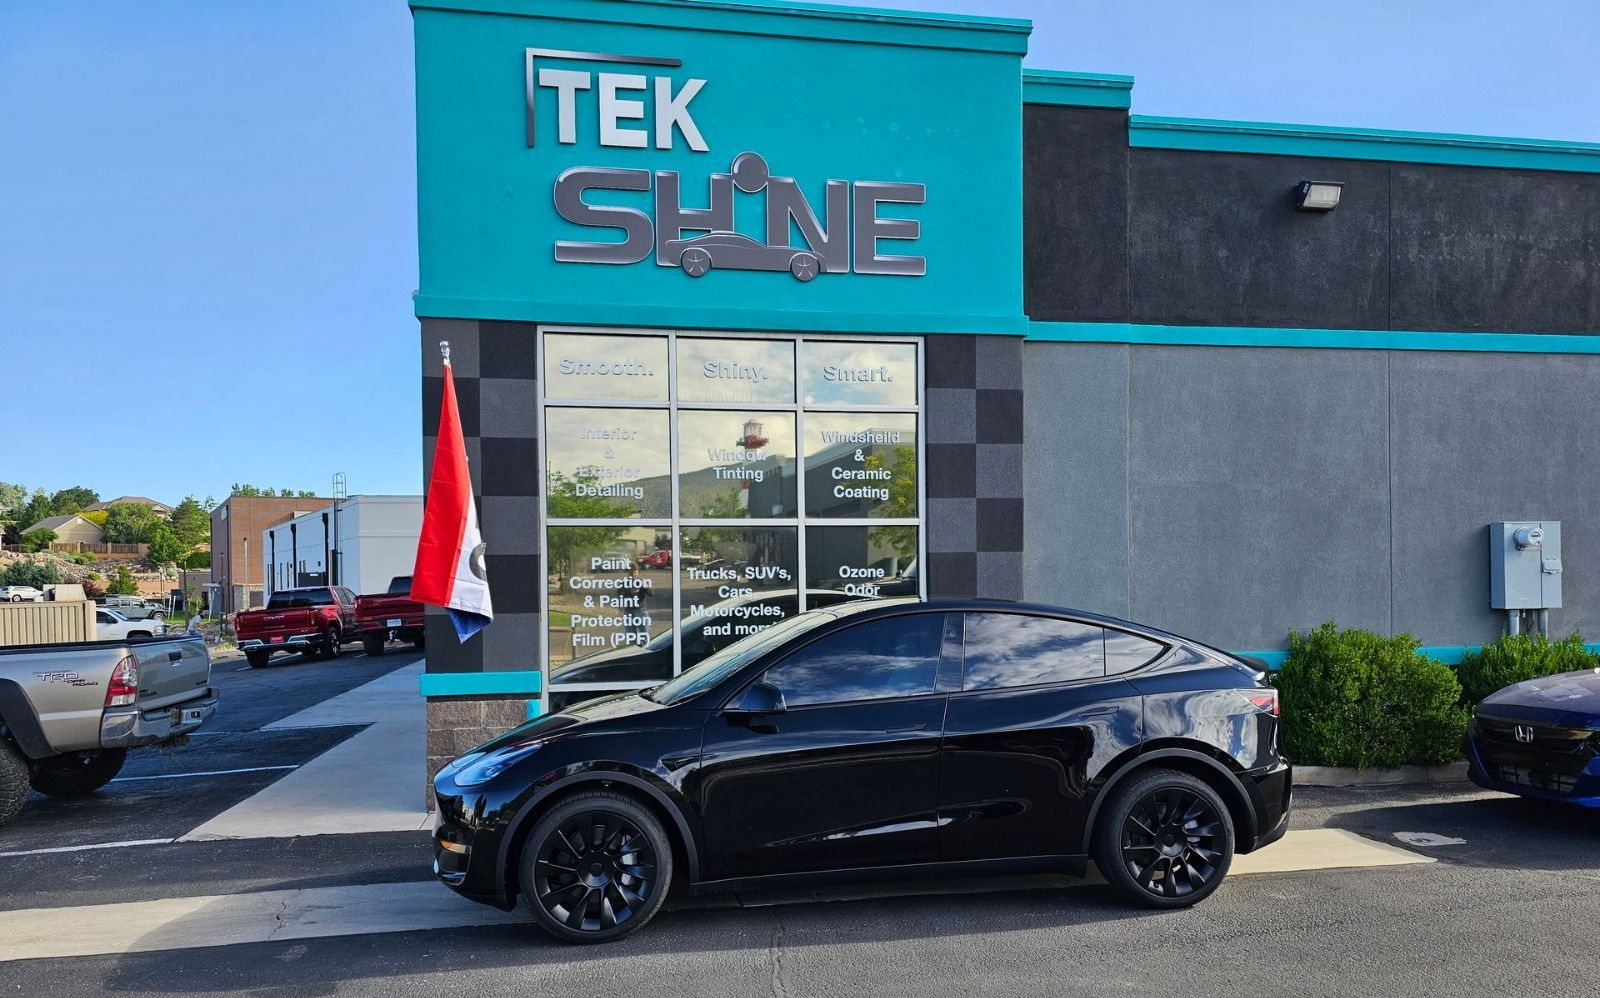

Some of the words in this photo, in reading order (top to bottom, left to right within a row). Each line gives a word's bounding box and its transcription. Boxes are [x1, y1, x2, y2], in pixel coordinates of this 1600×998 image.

[539, 69, 709, 152] TEK
[554, 152, 926, 277] SHINE
[559, 358, 654, 376] Smooth.
[703, 360, 768, 383] Shiny.
[823, 365, 893, 382] Smart.
[581, 427, 637, 440] Interior
[821, 431, 900, 443] Windsheild
[604, 447, 615, 459] &
[708, 448, 767, 461] Window
[854, 449, 865, 462] &
[579, 465, 640, 479] Exterior
[713, 467, 764, 482] Tinting
[831, 467, 892, 480] Ceramic
[575, 484, 644, 499] Detailing
[833, 486, 889, 500] Coating
[591, 557, 632, 570] Paint
[687, 567, 740, 582] Trucks,
[838, 565, 885, 578] Ozone
[569, 576, 653, 589] Correction
[844, 583, 881, 596] Odor
[718, 585, 757, 599] Cars,
[583, 595, 595, 608] &
[600, 595, 640, 608] Paint
[690, 603, 785, 619] Motorcycles,
[571, 614, 652, 627] Protection
[703, 622, 731, 636] and
[735, 621, 777, 635] mor
[572, 633, 605, 646] Film
[610, 632, 651, 648] (PPF)
[37, 671, 79, 683] TRD
